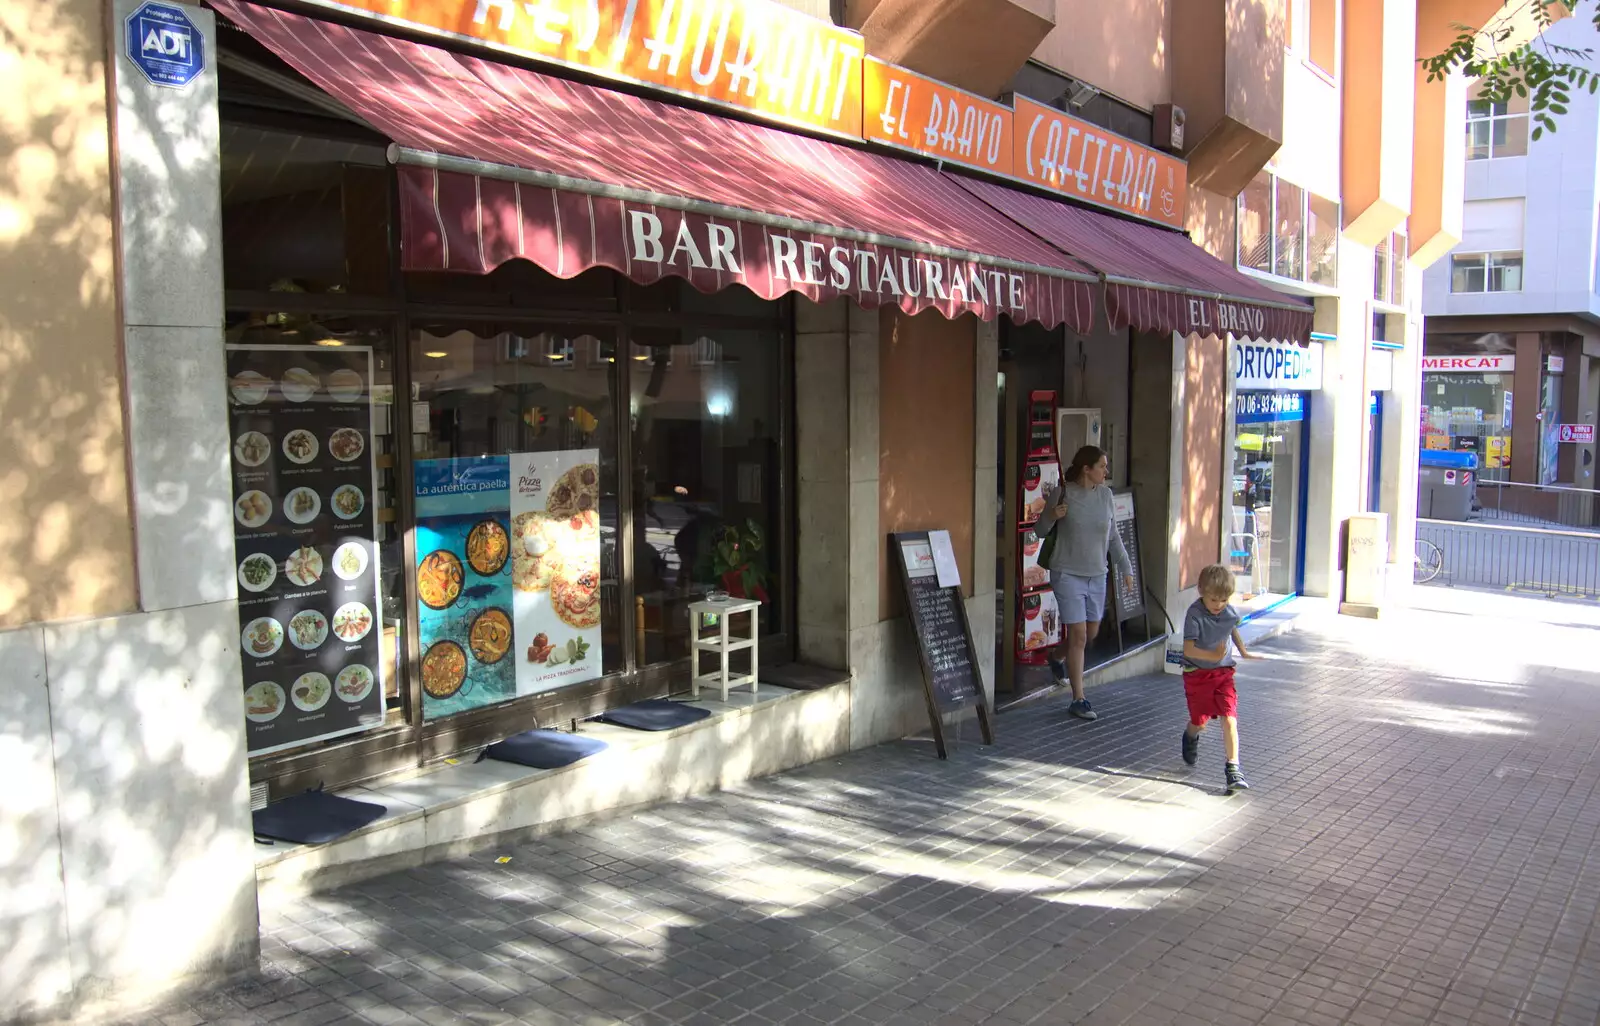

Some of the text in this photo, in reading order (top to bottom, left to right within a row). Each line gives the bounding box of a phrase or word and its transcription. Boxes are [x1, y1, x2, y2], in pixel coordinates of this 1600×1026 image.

[142, 28, 192, 58] ADT
[879, 79, 1002, 164] EL BRAVO
[1025, 113, 1157, 212] CAFETERIA
[628, 209, 1025, 310] BAR RESTAURANTE
[1189, 299, 1264, 332] EL BRAVO
[1422, 357, 1503, 369] MERCAT
[1247, 394, 1256, 413] 06
[1261, 394, 1269, 413] 93
[416, 485, 428, 495] La
[479, 479, 506, 491] paella
[518, 475, 541, 486] Pizza
